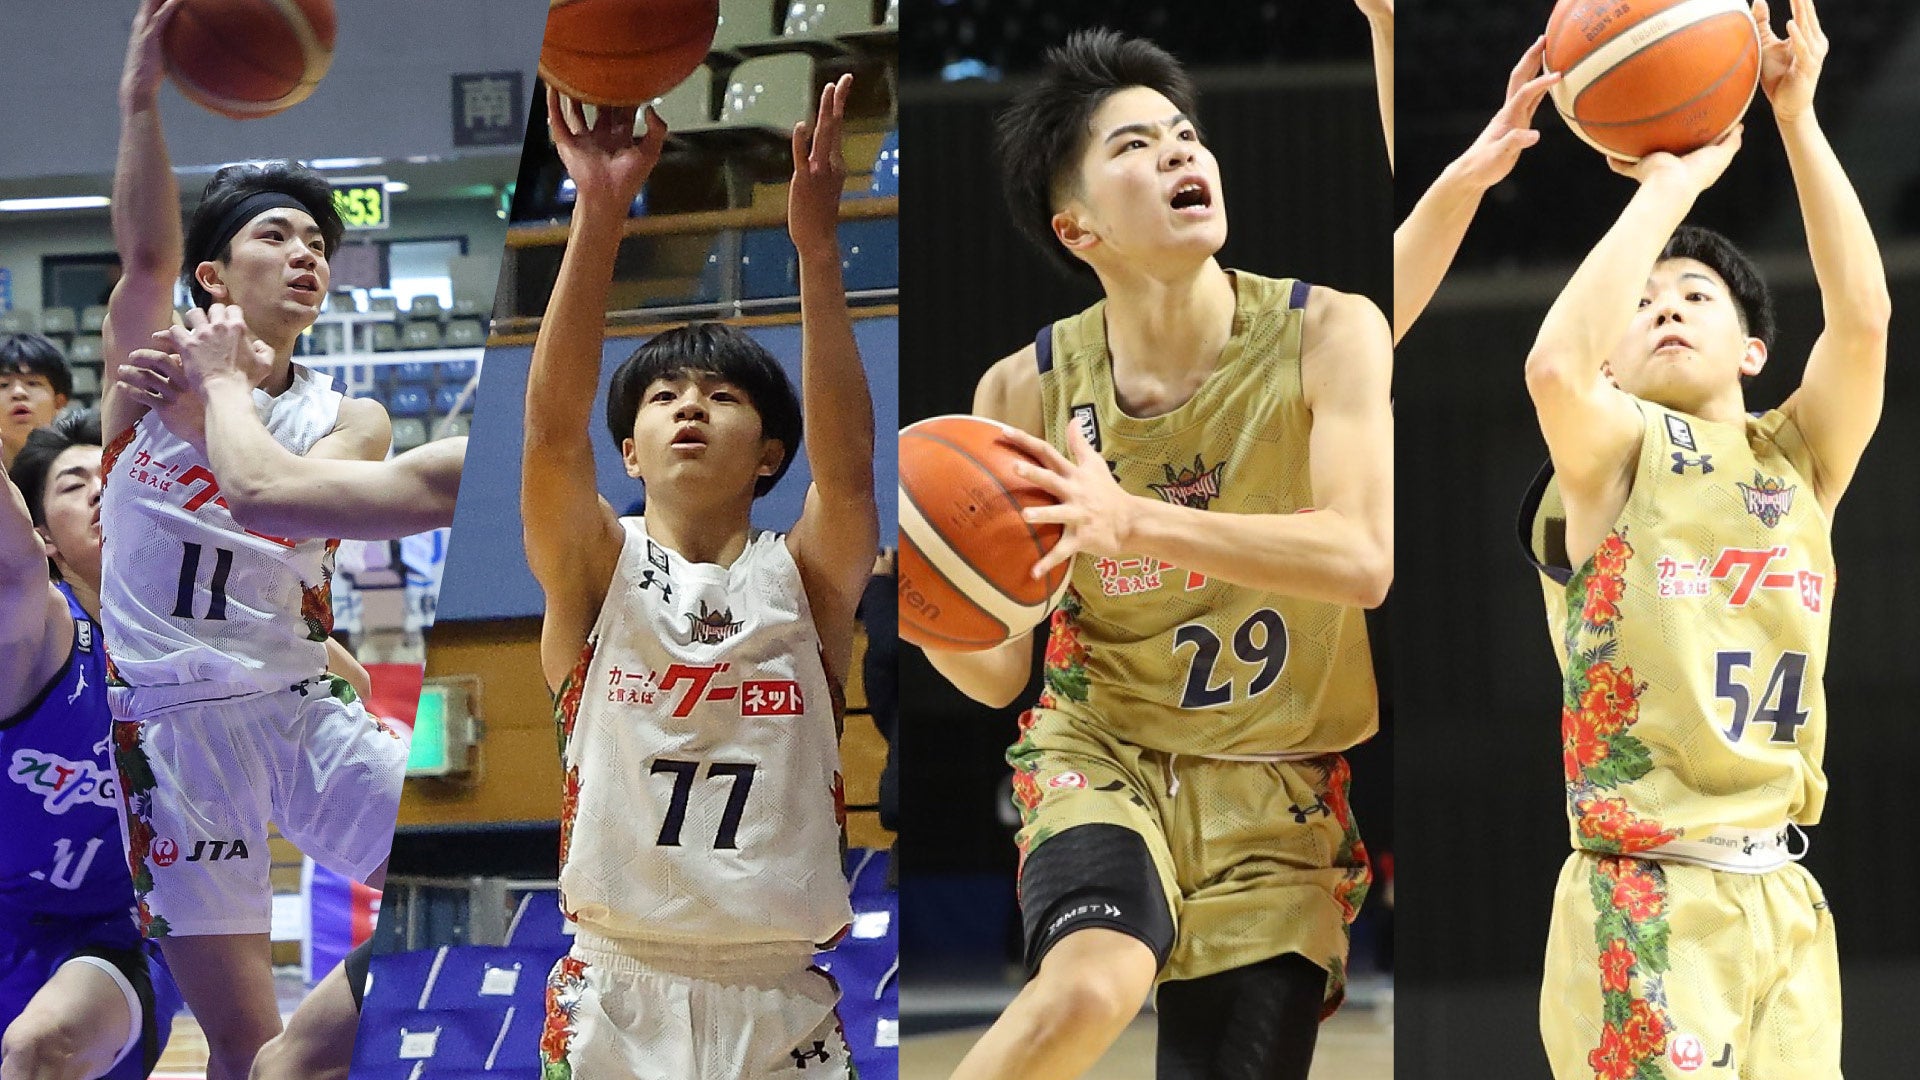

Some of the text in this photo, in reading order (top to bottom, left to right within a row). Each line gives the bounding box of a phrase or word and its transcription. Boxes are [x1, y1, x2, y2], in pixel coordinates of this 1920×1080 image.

[462, 77, 511, 128] 南
[134, 449, 180, 478] カー!
[128, 467, 173, 492] と言えば
[1097, 557, 1150, 578] カー!
[1657, 557, 1707, 579] カー!
[170, 541, 234, 621] 11
[1104, 574, 1160, 594] と言えば
[1172, 607, 1288, 710] 29
[608, 665, 657, 688] カー!
[607, 688, 655, 705] と言えば
[1713, 651, 1811, 744] 54
[650, 758, 757, 850] 77
[185, 839, 249, 862] JTA
